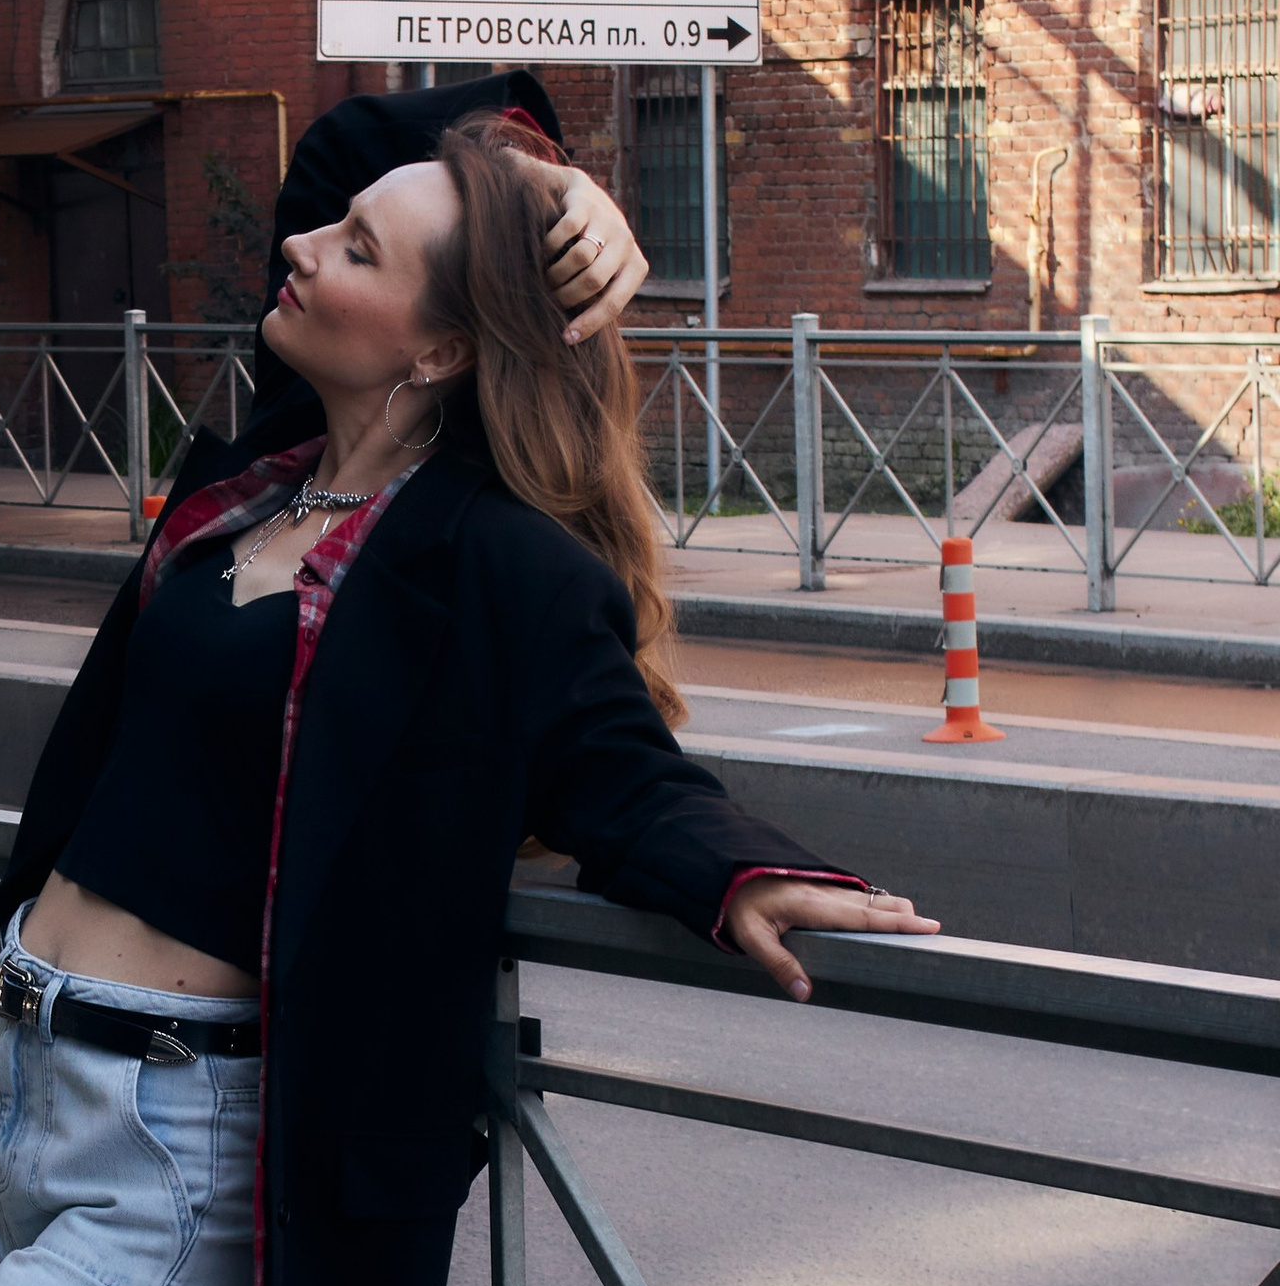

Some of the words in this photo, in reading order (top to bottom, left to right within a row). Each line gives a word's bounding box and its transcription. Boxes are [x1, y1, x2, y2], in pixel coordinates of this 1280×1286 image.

[397, 16, 595, 46] ПЕТРОВСКАЯ
[607, 27, 646, 46] пл.
[663, 20, 701, 47] 0.9
